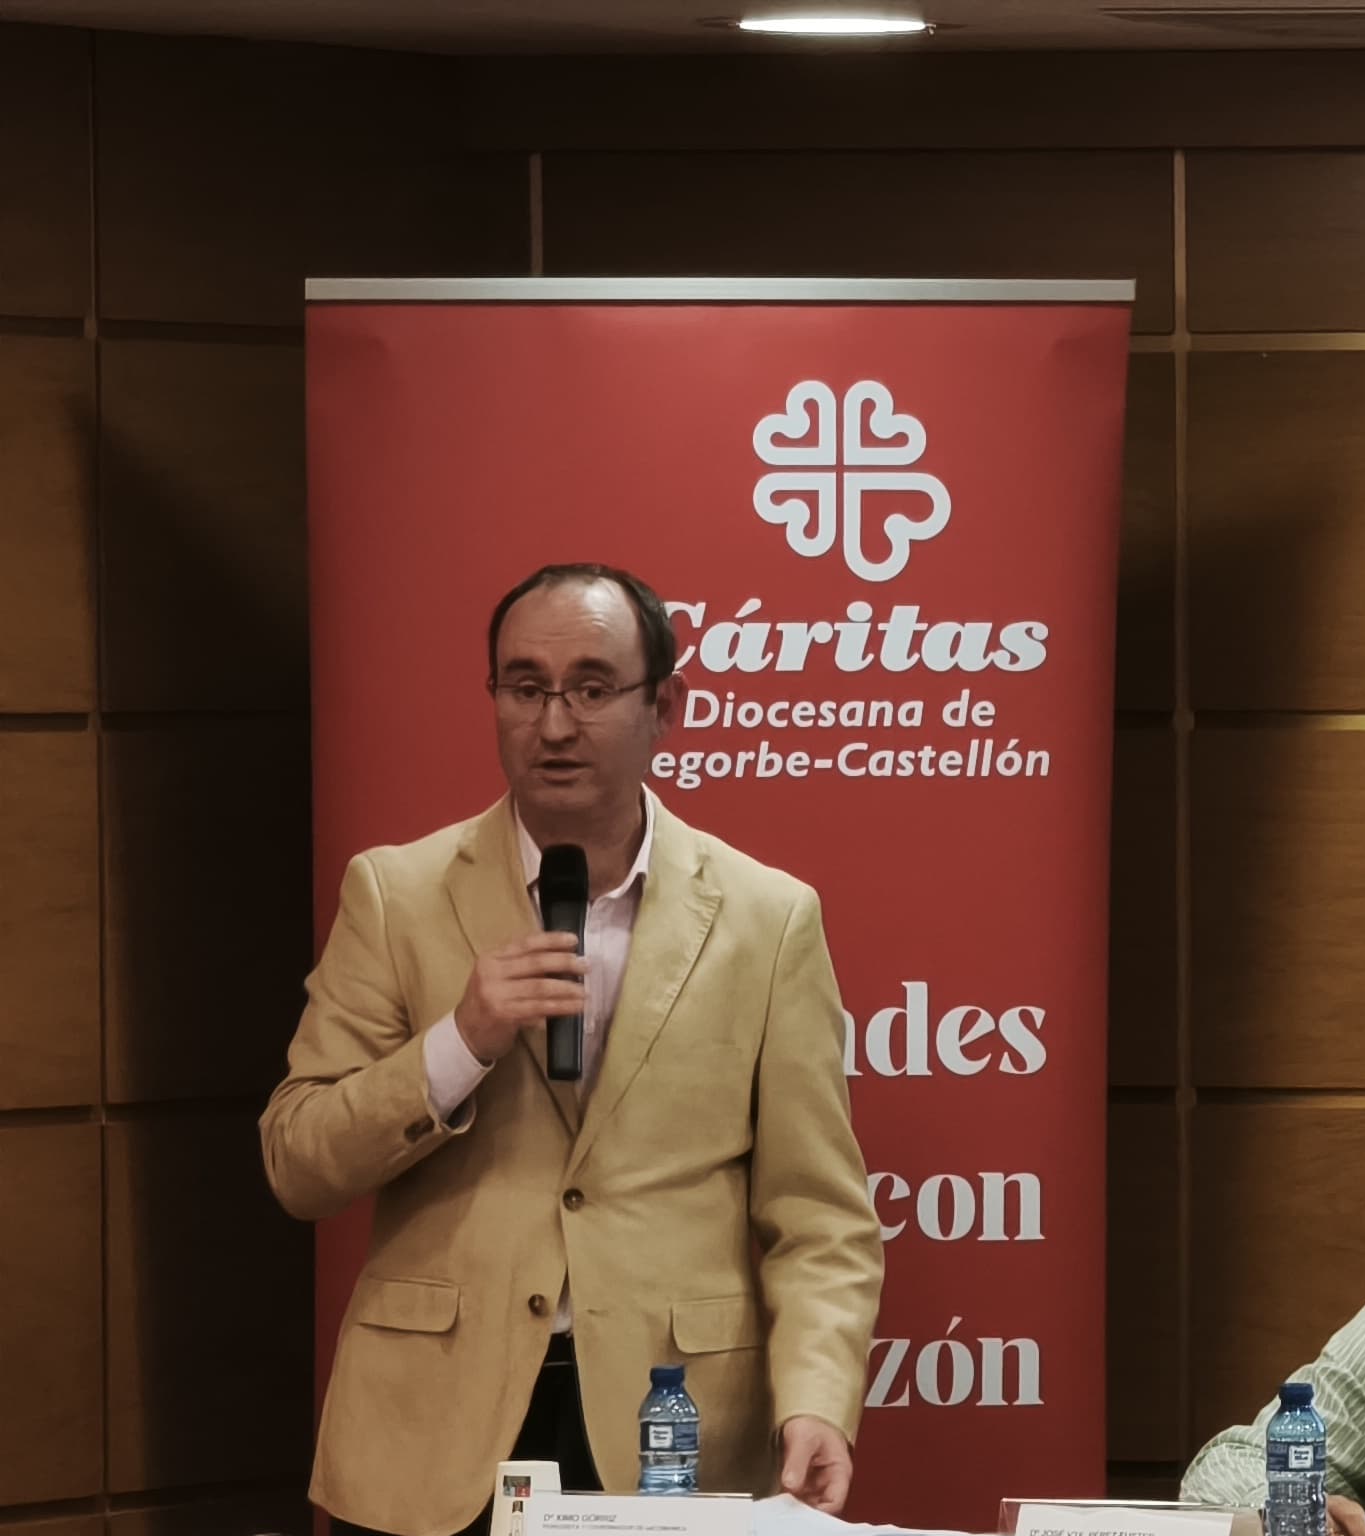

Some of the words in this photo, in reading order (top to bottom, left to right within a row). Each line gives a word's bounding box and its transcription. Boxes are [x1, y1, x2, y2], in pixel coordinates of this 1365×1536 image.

[683, 689, 924, 729] Diocesana
[942, 688, 997, 728] de
[651, 738, 1051, 790] egorbe-Castellón
[866, 1171, 1047, 1242] con
[864, 1316, 1046, 1409] zón
